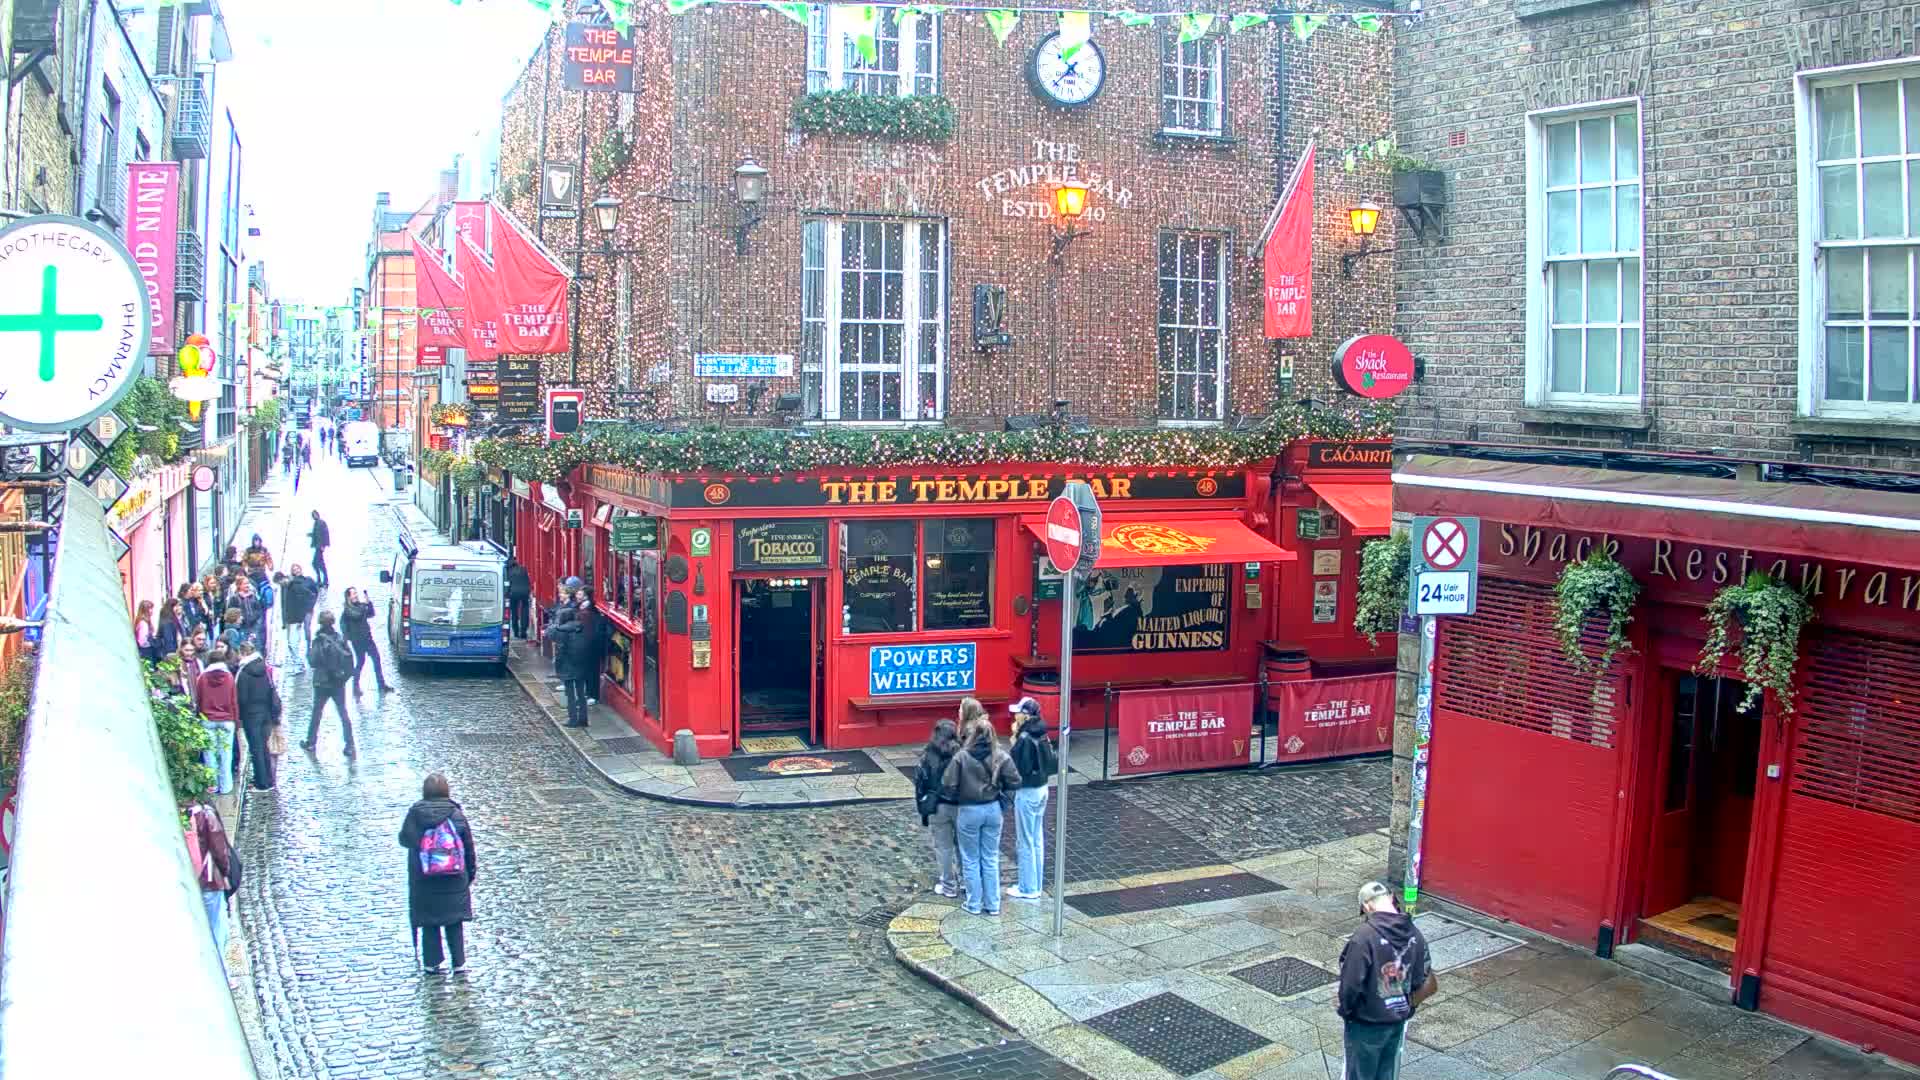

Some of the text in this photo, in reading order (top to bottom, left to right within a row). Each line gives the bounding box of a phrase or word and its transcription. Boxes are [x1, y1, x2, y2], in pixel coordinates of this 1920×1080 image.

[584, 28, 617, 45] THE
[568, 47, 632, 65] TEMPLE
[583, 69, 616, 84] BAR
[1032, 139, 1081, 162] THE
[975, 165, 1077, 202] TEMPLE
[136, 170, 169, 232] NINE
[1268, 286, 1307, 300] TEMPLE
[521, 304, 545, 313] THE
[502, 313, 564, 325] TEMPLE
[518, 326, 550, 337] BAR
[88, 302, 136, 401] PHARMACY
[1355, 348, 1388, 371] Shack
[823, 478, 1132, 503] THE TEMPLE AR
[748, 538, 815, 562] TOBACCO
[1499, 522, 1620, 567] Shack
[846, 565, 891, 587] TEMPLE
[1121, 567, 1145, 578] BAR
[1202, 564, 1225, 577] THE
[433, 577, 493, 586] BLACKWELL
[1175, 578, 1225, 593] EMPEROR
[1211, 593, 1224, 607] OF
[1420, 583, 1443, 602] 24
[1444, 593, 1465, 602] HOUR
[1137, 608, 1226, 632] MALTED LIQUORS
[1131, 630, 1224, 650] GUINNESS
[879, 647, 969, 667] POWER'S
[872, 670, 973, 690] WHISKEY
[1304, 704, 1371, 722] TEMPLE BAR
[1330, 699, 1348, 709] THE
[1147, 716, 1226, 734] TEMPLE BAR
[1177, 711, 1198, 721] THE
